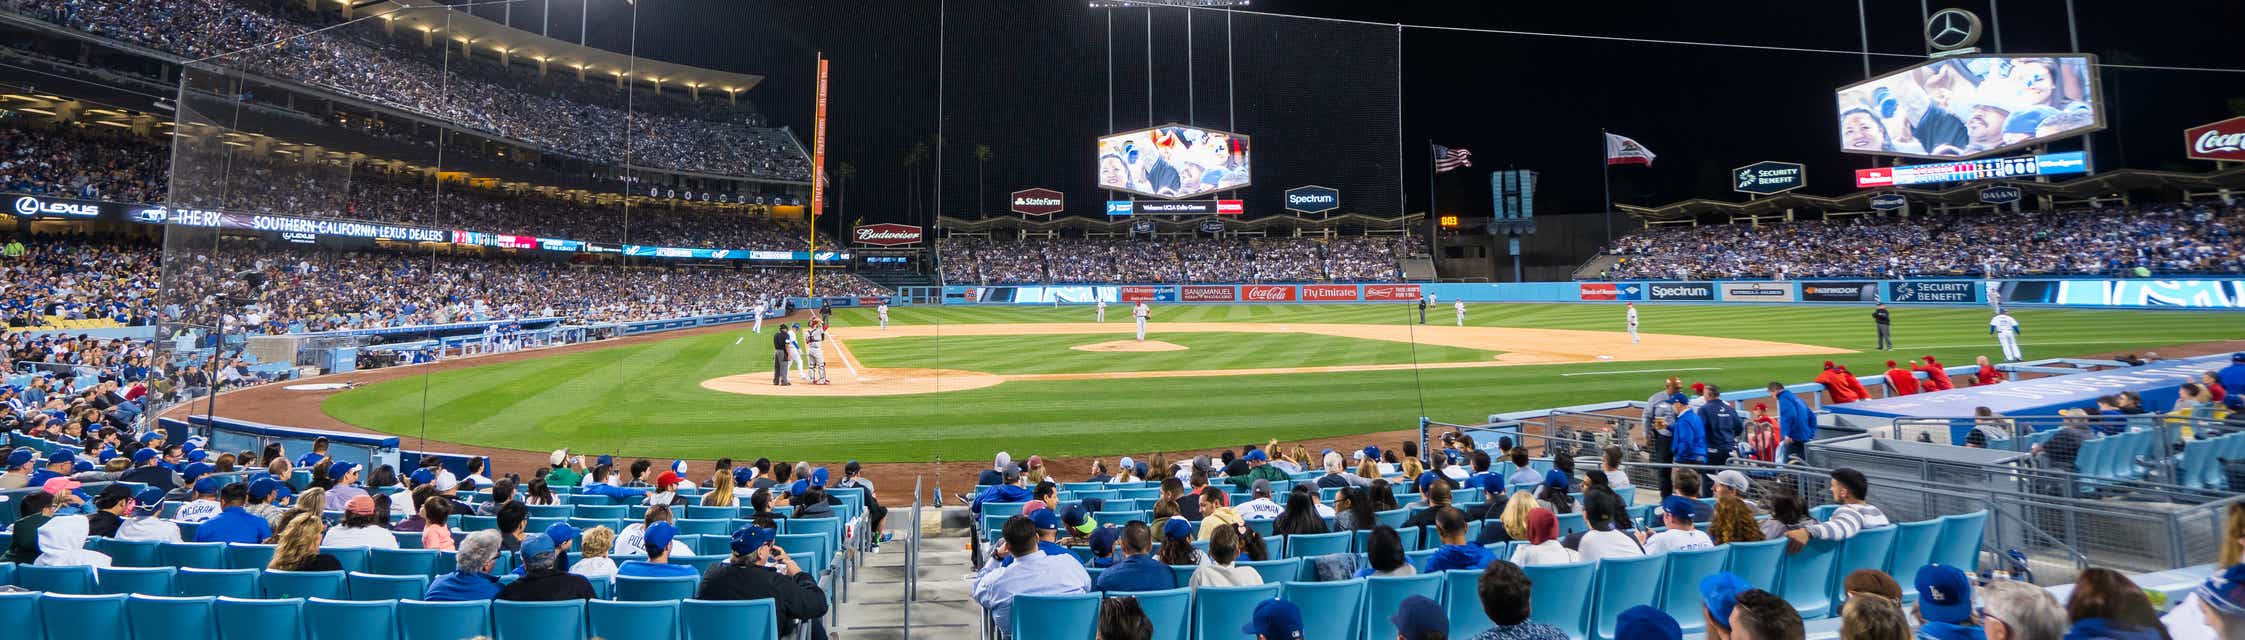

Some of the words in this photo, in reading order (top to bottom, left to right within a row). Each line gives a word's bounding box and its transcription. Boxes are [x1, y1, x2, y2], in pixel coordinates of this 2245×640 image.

[1758, 168, 1798, 177] SECURITY
[1758, 176, 1792, 185] BENEFIT
[1289, 194, 1332, 205] Spectrum
[39, 201, 99, 216] LEXUS
[177, 208, 202, 225] THE
[203, 210, 223, 226] RX
[253, 215, 316, 233] SOUTHERN
[318, 220, 377, 238] CALIFORNIA
[379, 226, 407, 239] LEXUS
[408, 228, 444, 242] DEALERS
[856, 228, 920, 240] Budweiser
[1205, 287, 1233, 296] MANUEL
[1303, 288, 1319, 298] Fly
[1320, 287, 1357, 297] Emirates
[1651, 285, 1707, 298] Spectrum
[1917, 283, 1969, 292] SECURITY
[1917, 292, 1963, 301] BENEFIT
